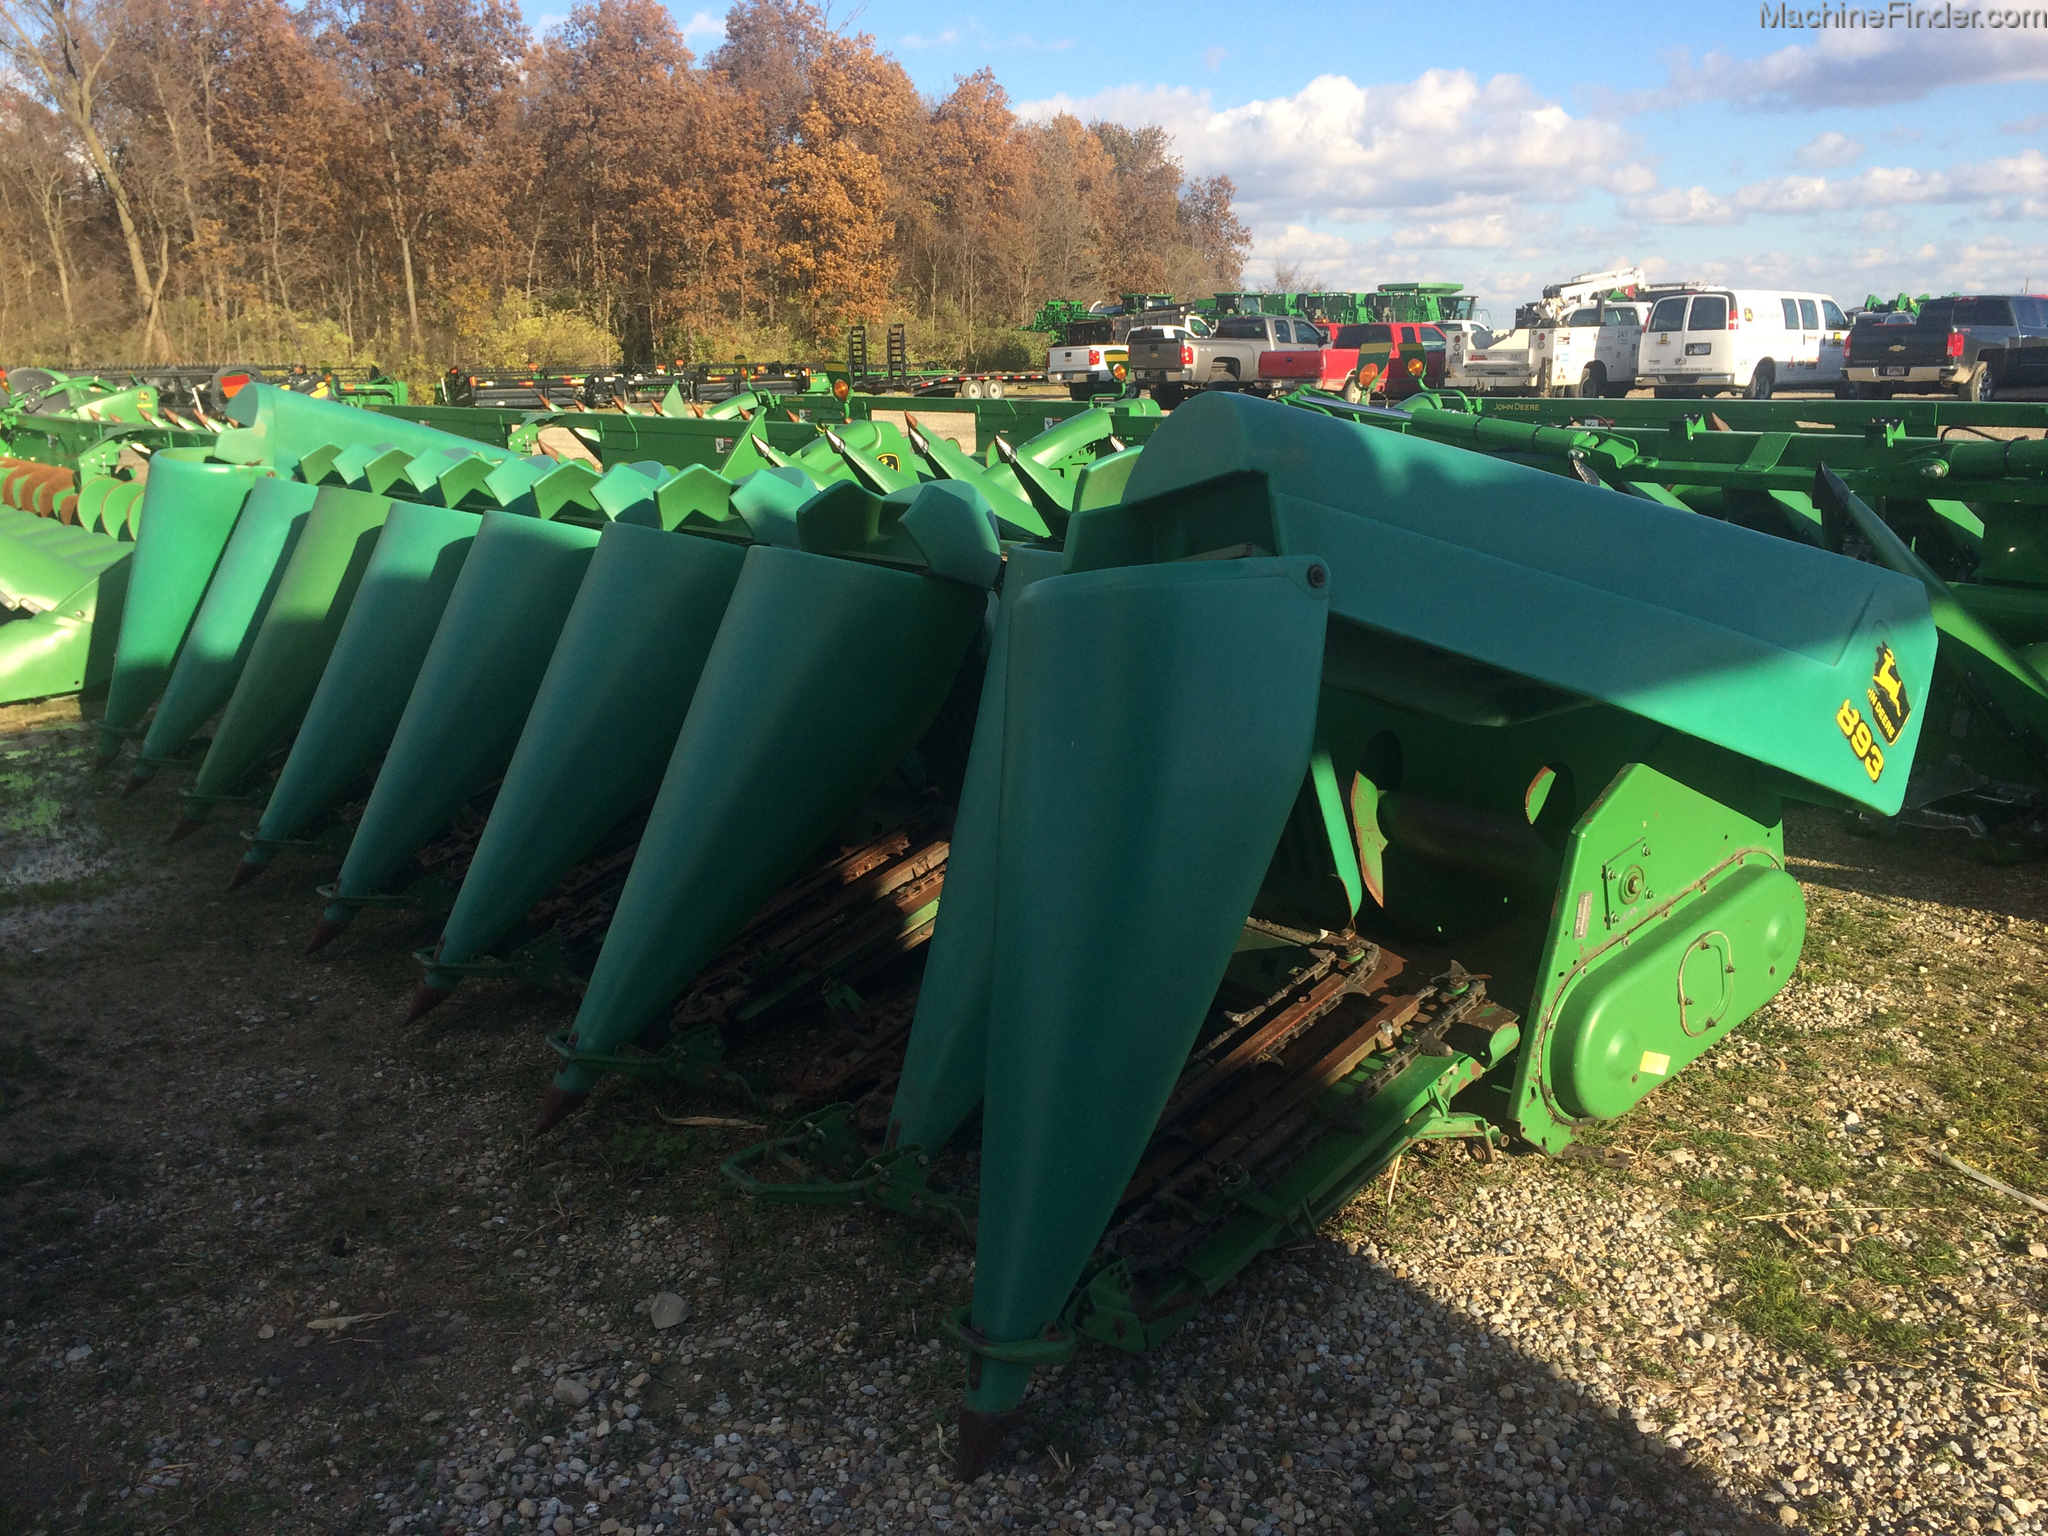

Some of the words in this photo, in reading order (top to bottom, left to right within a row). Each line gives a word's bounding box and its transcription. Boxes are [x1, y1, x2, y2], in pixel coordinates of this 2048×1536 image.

[1494, 402, 1513, 411] JOHN
[1514, 402, 1540, 411] DEERE
[1874, 701, 1896, 739] DEERE
[1836, 698, 1885, 784] 893
